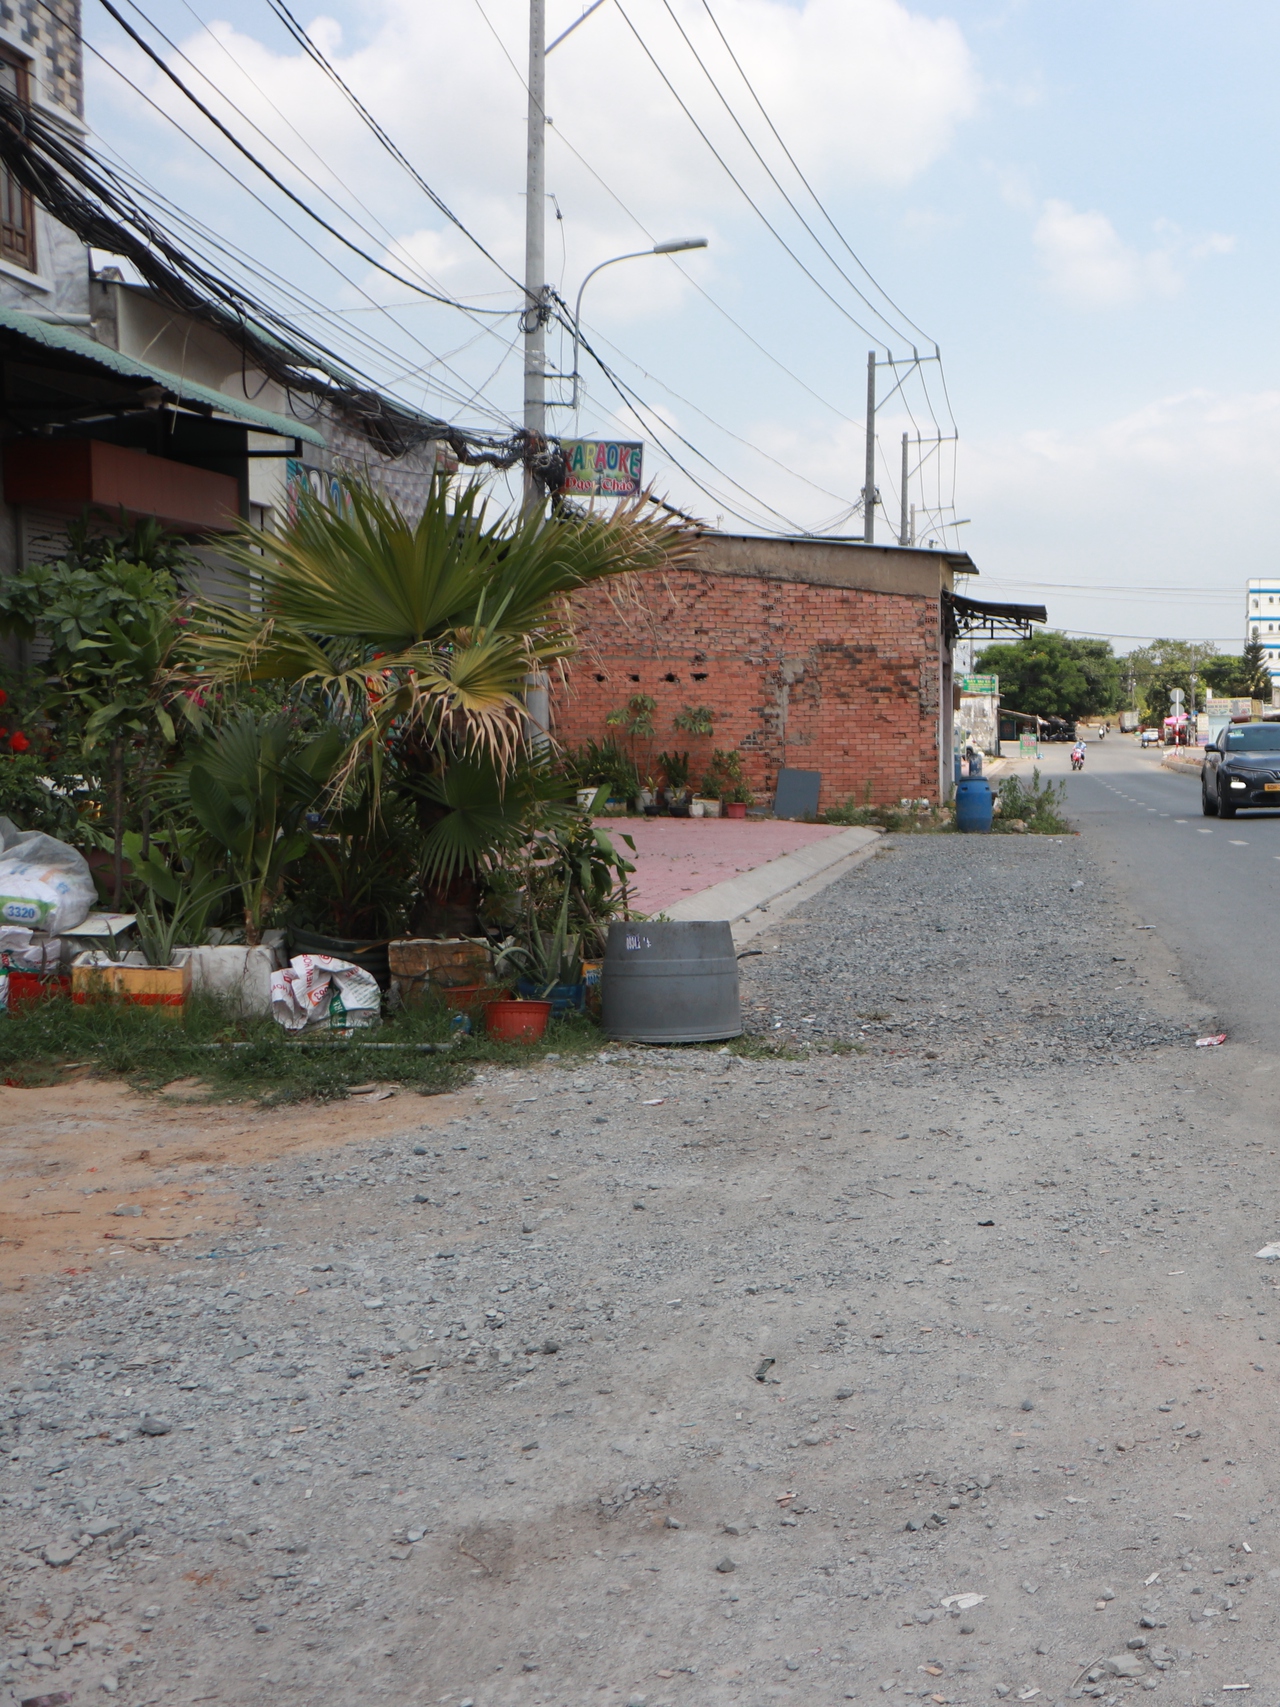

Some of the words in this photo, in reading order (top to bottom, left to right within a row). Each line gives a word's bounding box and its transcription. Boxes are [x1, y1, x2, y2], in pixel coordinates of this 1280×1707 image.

[564, 443, 641, 478] KARAOKE
[7, 905, 36, 919] 3320
[306, 969, 314, 988] NEW
